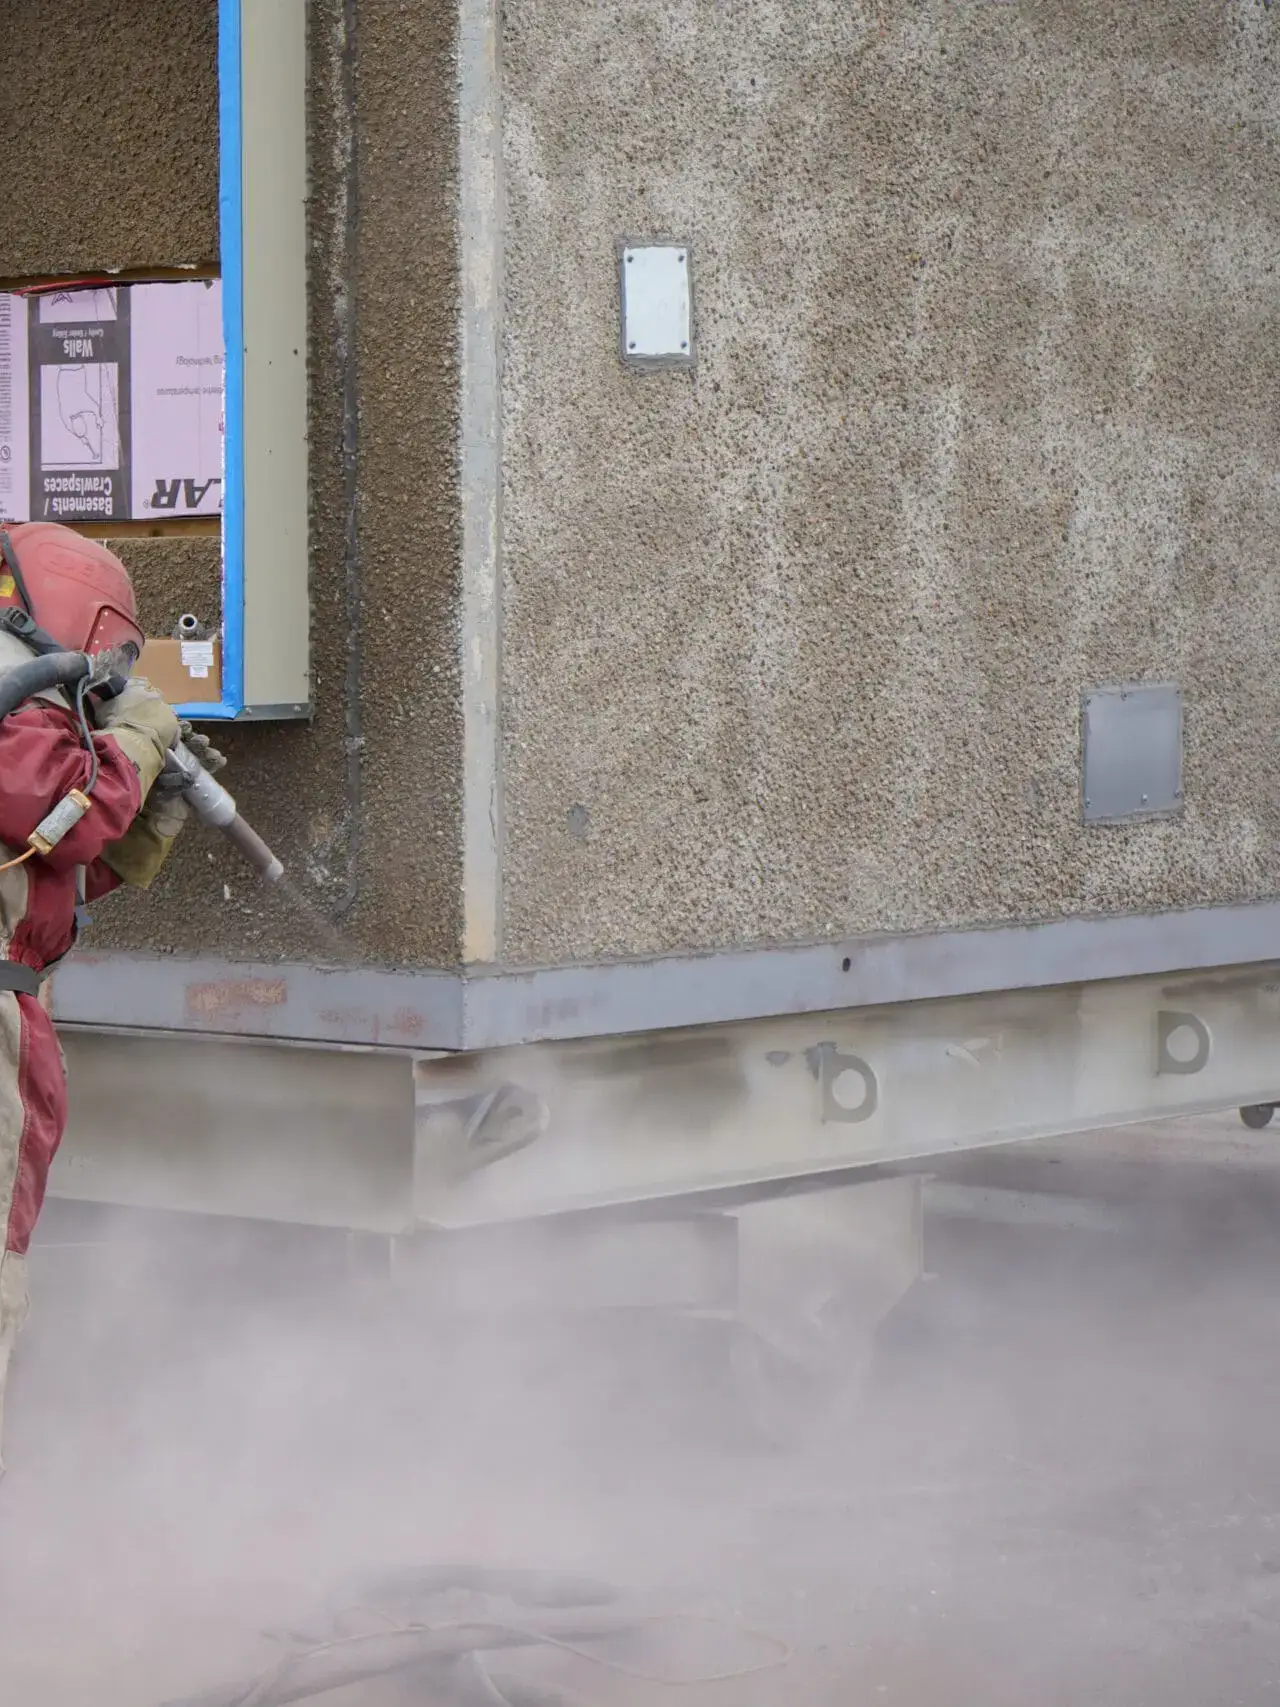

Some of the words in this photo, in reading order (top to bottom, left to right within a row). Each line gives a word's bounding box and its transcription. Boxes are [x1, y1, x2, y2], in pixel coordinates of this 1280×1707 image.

[63, 340, 93, 357] Walls
[44, 473, 112, 496] Crawlspaces
[52, 497, 113, 515] Basements
